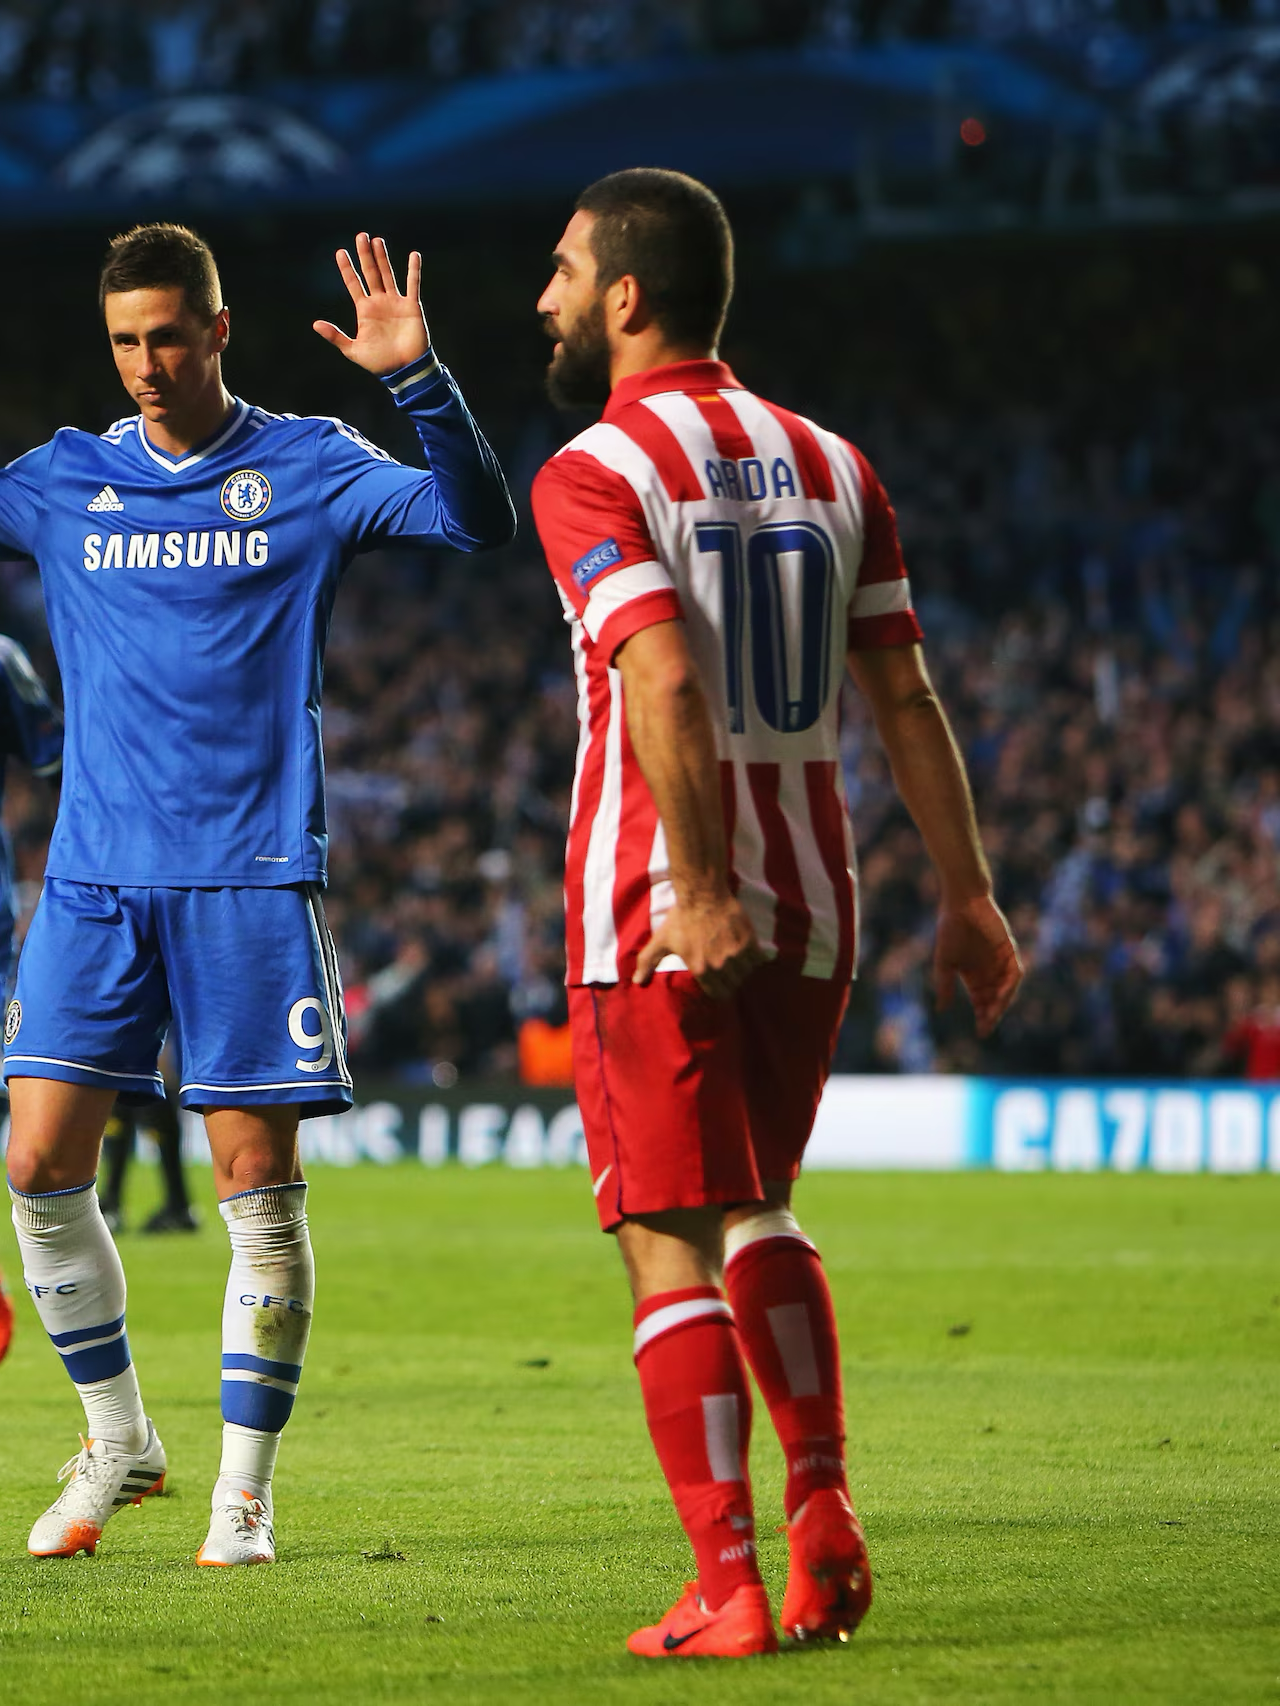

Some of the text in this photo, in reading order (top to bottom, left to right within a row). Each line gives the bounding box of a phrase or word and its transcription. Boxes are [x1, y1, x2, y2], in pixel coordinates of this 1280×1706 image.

[231, 473, 262, 485] CHELSEA
[704, 456, 797, 502] ARDA
[87, 502, 125, 513] adidas
[83, 530, 269, 572] SAMSUNG
[694, 520, 836, 735] 10
[288, 997, 333, 1073] 9
[24, 1280, 77, 1299] FC
[239, 1294, 304, 1313] CFC
